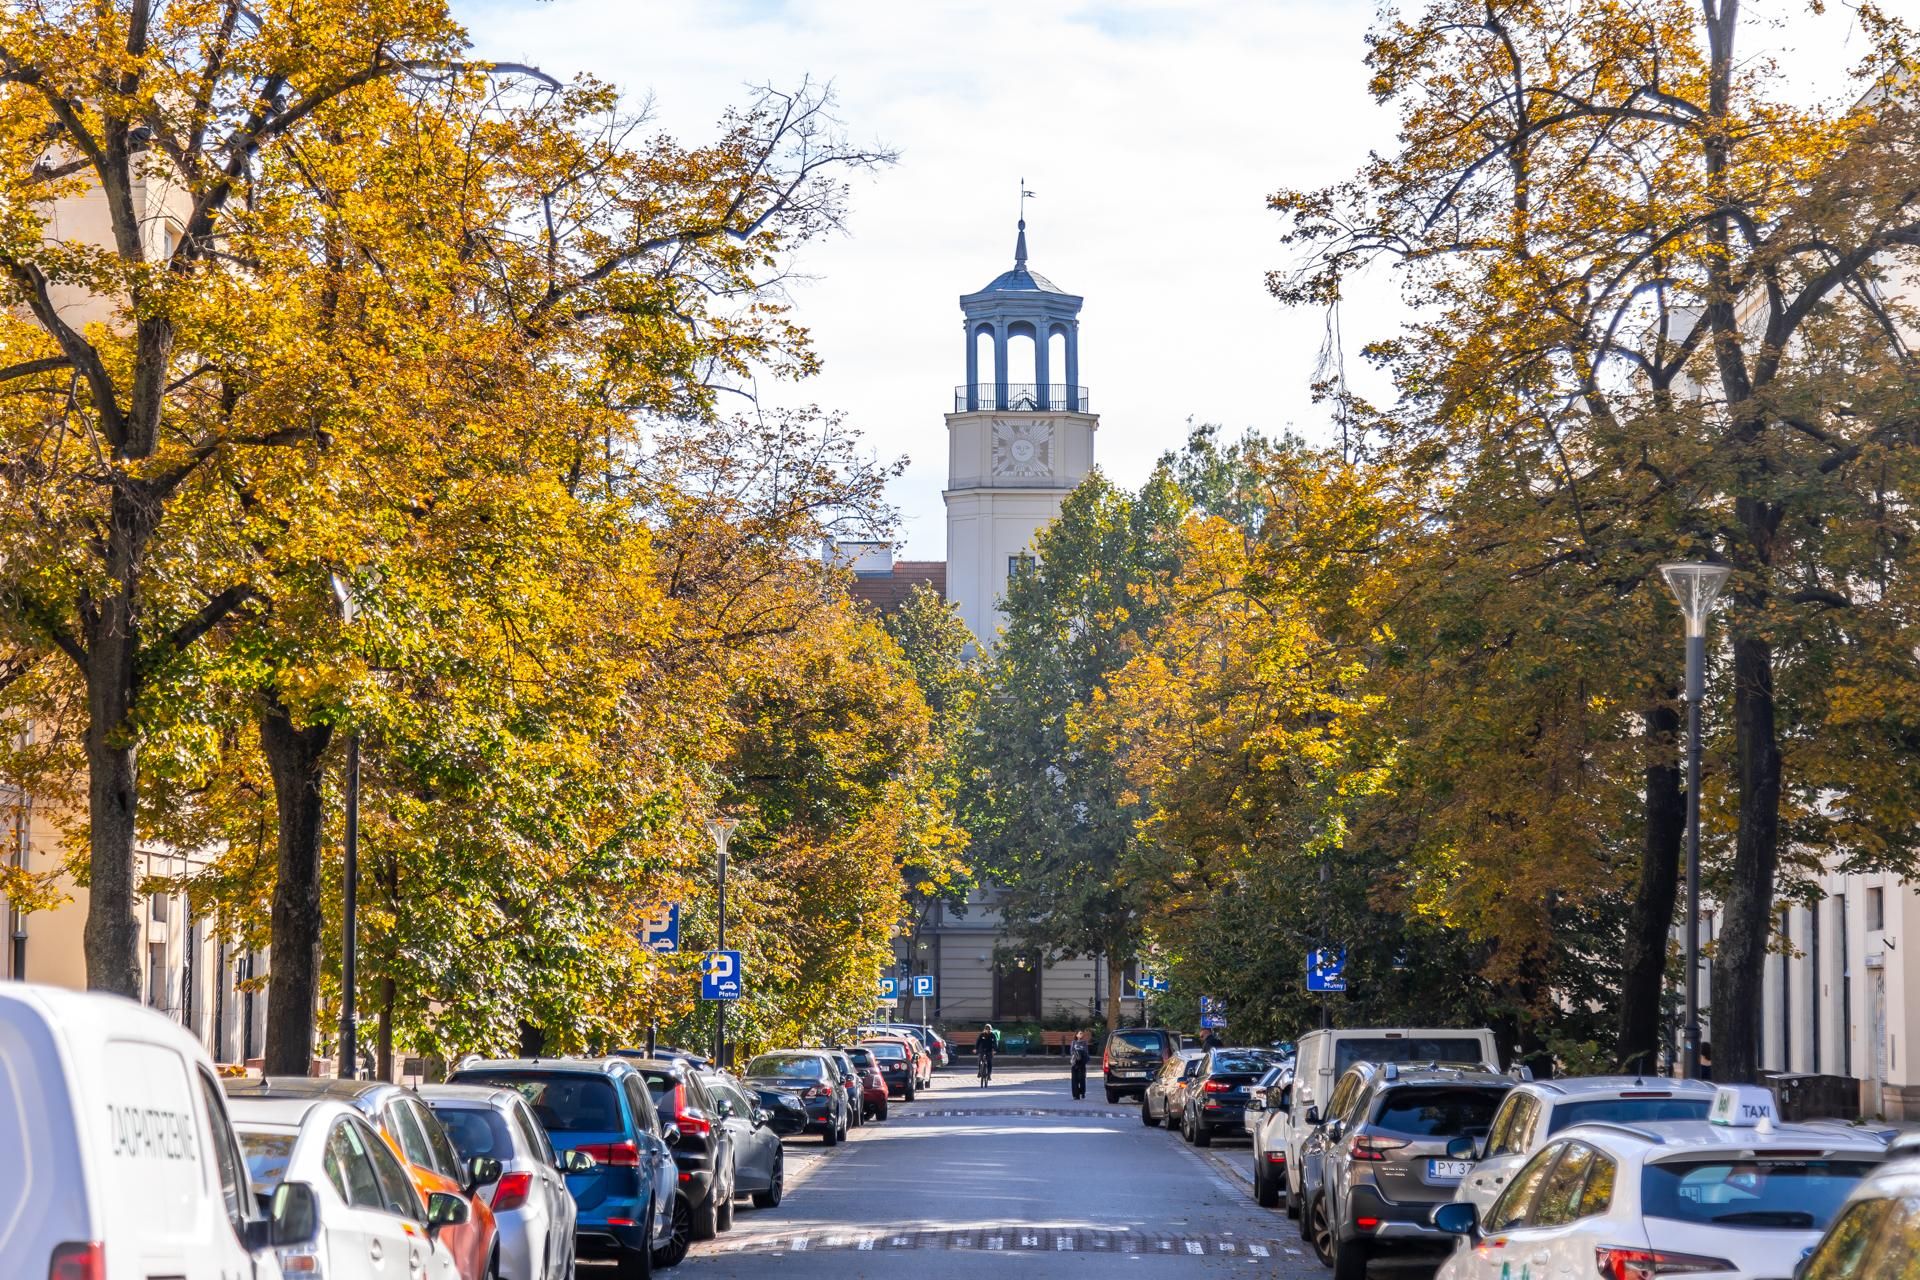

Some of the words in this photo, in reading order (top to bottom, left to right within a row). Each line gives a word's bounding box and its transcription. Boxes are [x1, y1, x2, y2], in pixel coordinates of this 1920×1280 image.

[711, 955, 733, 985] P
[882, 981, 893, 996] P
[918, 979, 929, 993] P
[1742, 1104, 1770, 1119] TAXI
[1438, 1162, 1455, 1176] PY
